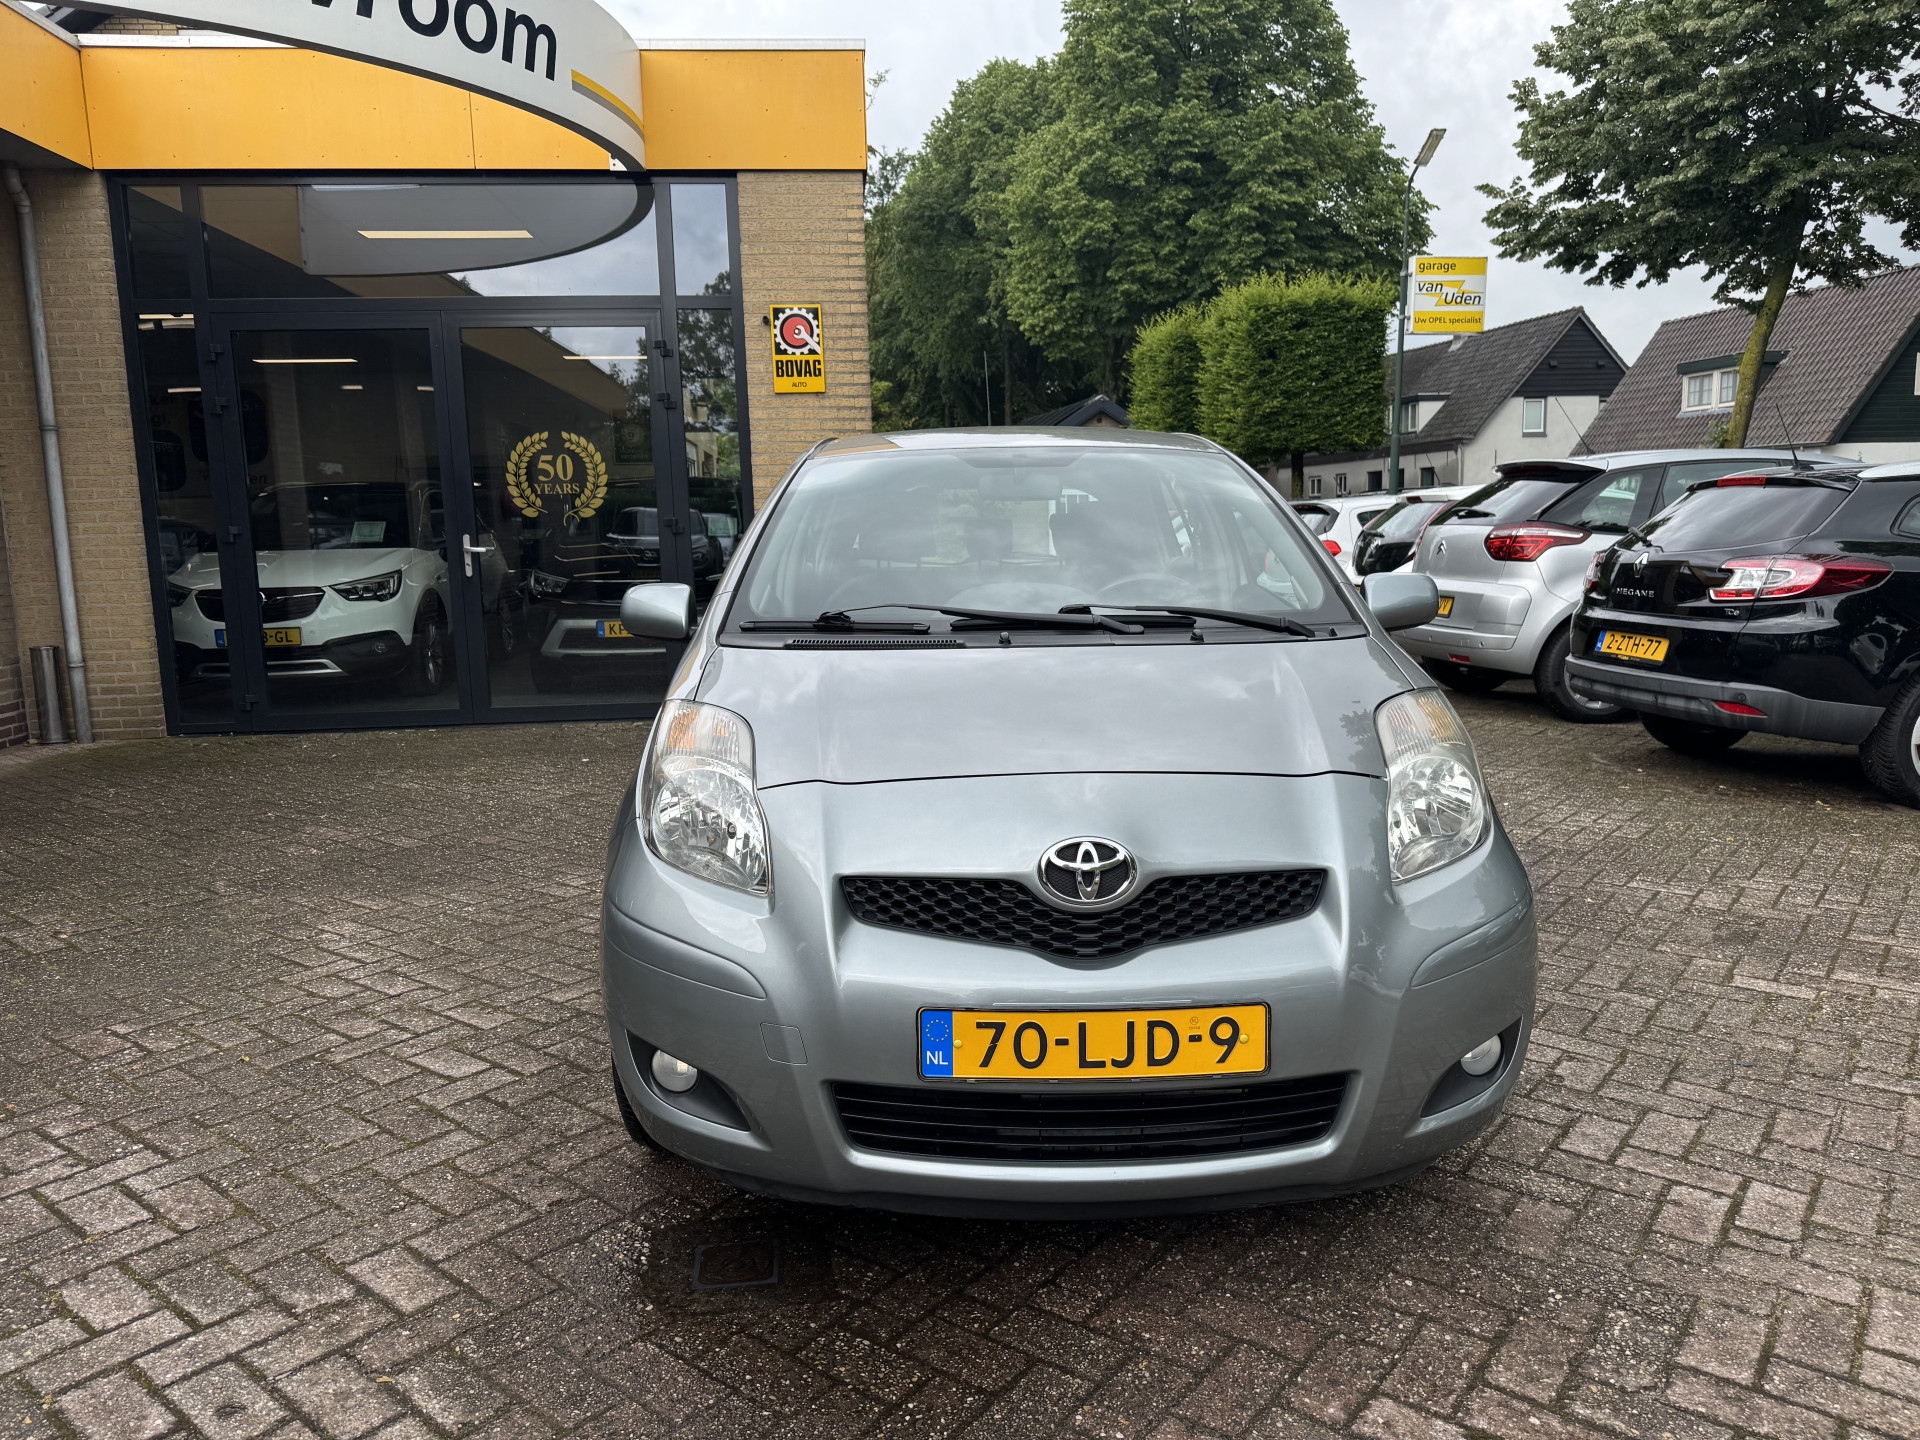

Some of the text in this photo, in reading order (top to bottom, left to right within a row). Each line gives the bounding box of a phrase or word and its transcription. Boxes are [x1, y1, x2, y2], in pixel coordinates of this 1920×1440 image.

[311, 0, 557, 81] oom
[1418, 262, 1456, 272] garage
[1418, 282, 1443, 292] van
[1444, 292, 1481, 305] Uden
[1449, 316, 1481, 325] specialist
[775, 359, 822, 378] BOVAG
[537, 454, 574, 481] 50
[533, 483, 580, 495] YEARS
[1606, 633, 1662, 656] 2-ZTH-77
[975, 1016, 1240, 1069] 70-LJD-9
[926, 1050, 949, 1066] NL
